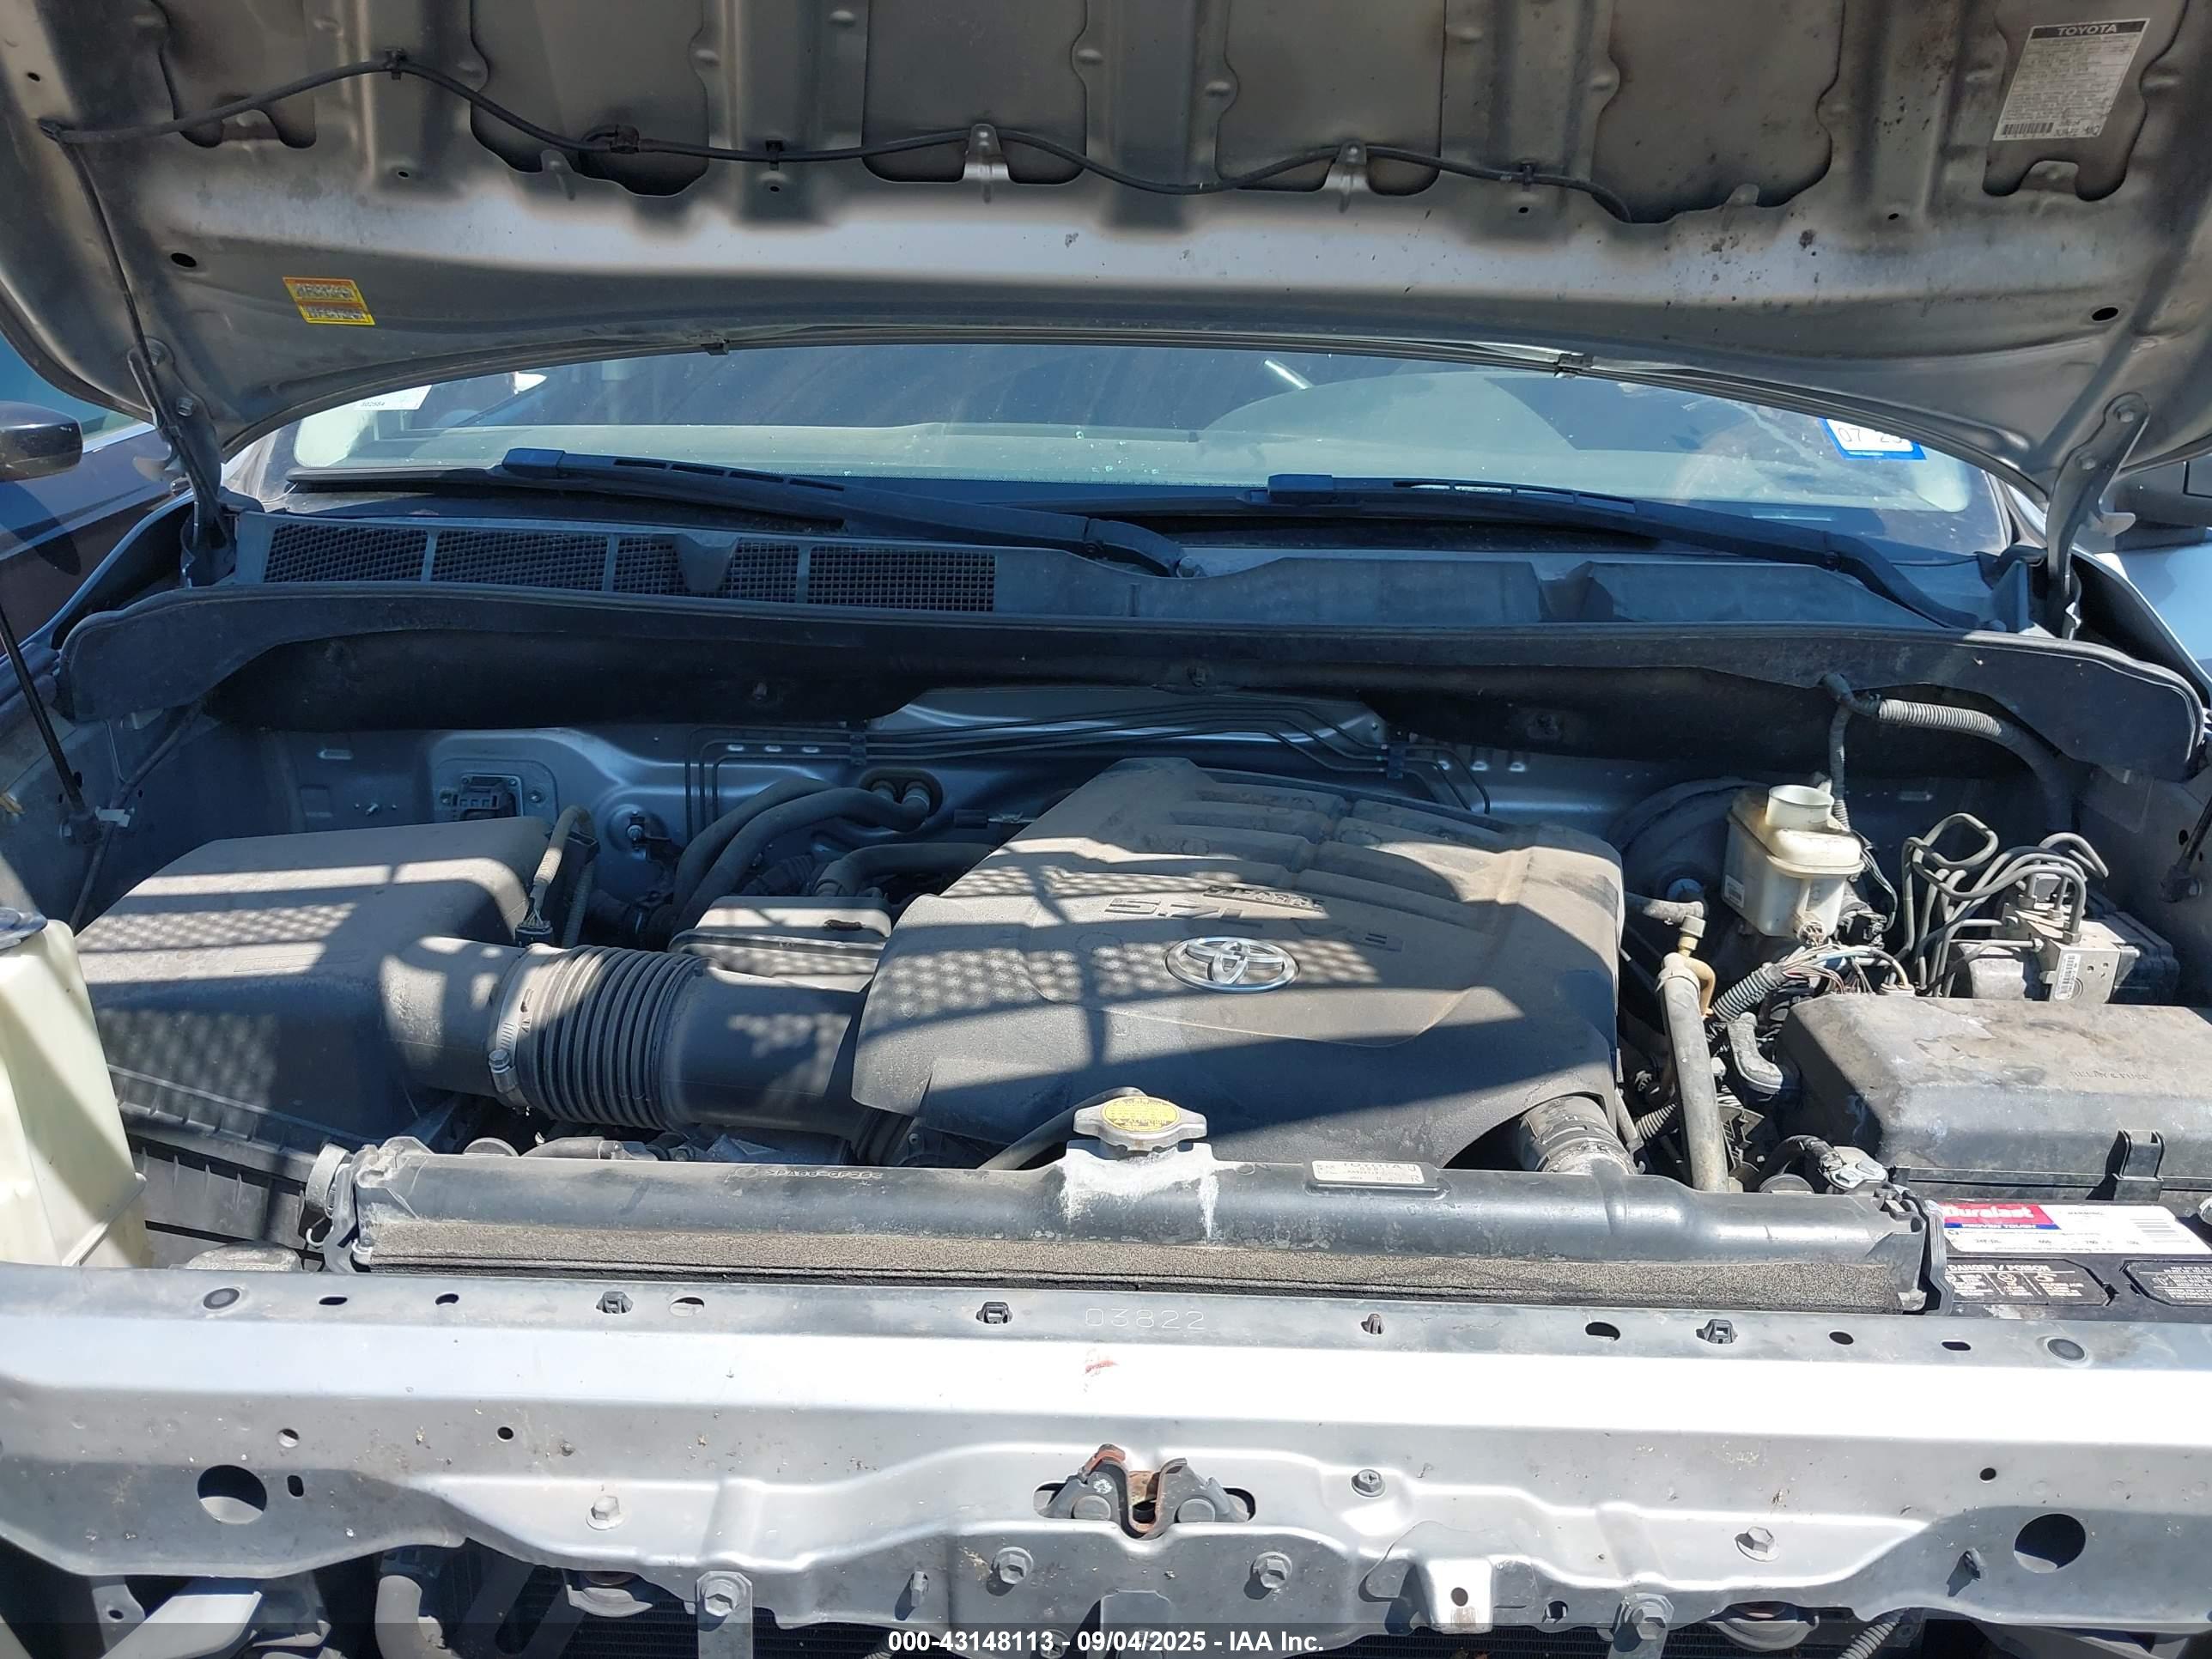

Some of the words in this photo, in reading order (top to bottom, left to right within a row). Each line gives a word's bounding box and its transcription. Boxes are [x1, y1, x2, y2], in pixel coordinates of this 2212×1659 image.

[2057, 24, 2118, 36] TOYOTA
[1838, 428, 1861, 443] 07
[1104, 897, 1263, 929] 5.7L
[1943, 1204, 2034, 1218] Duralast
[1085, 1308, 1206, 1330] 03822
